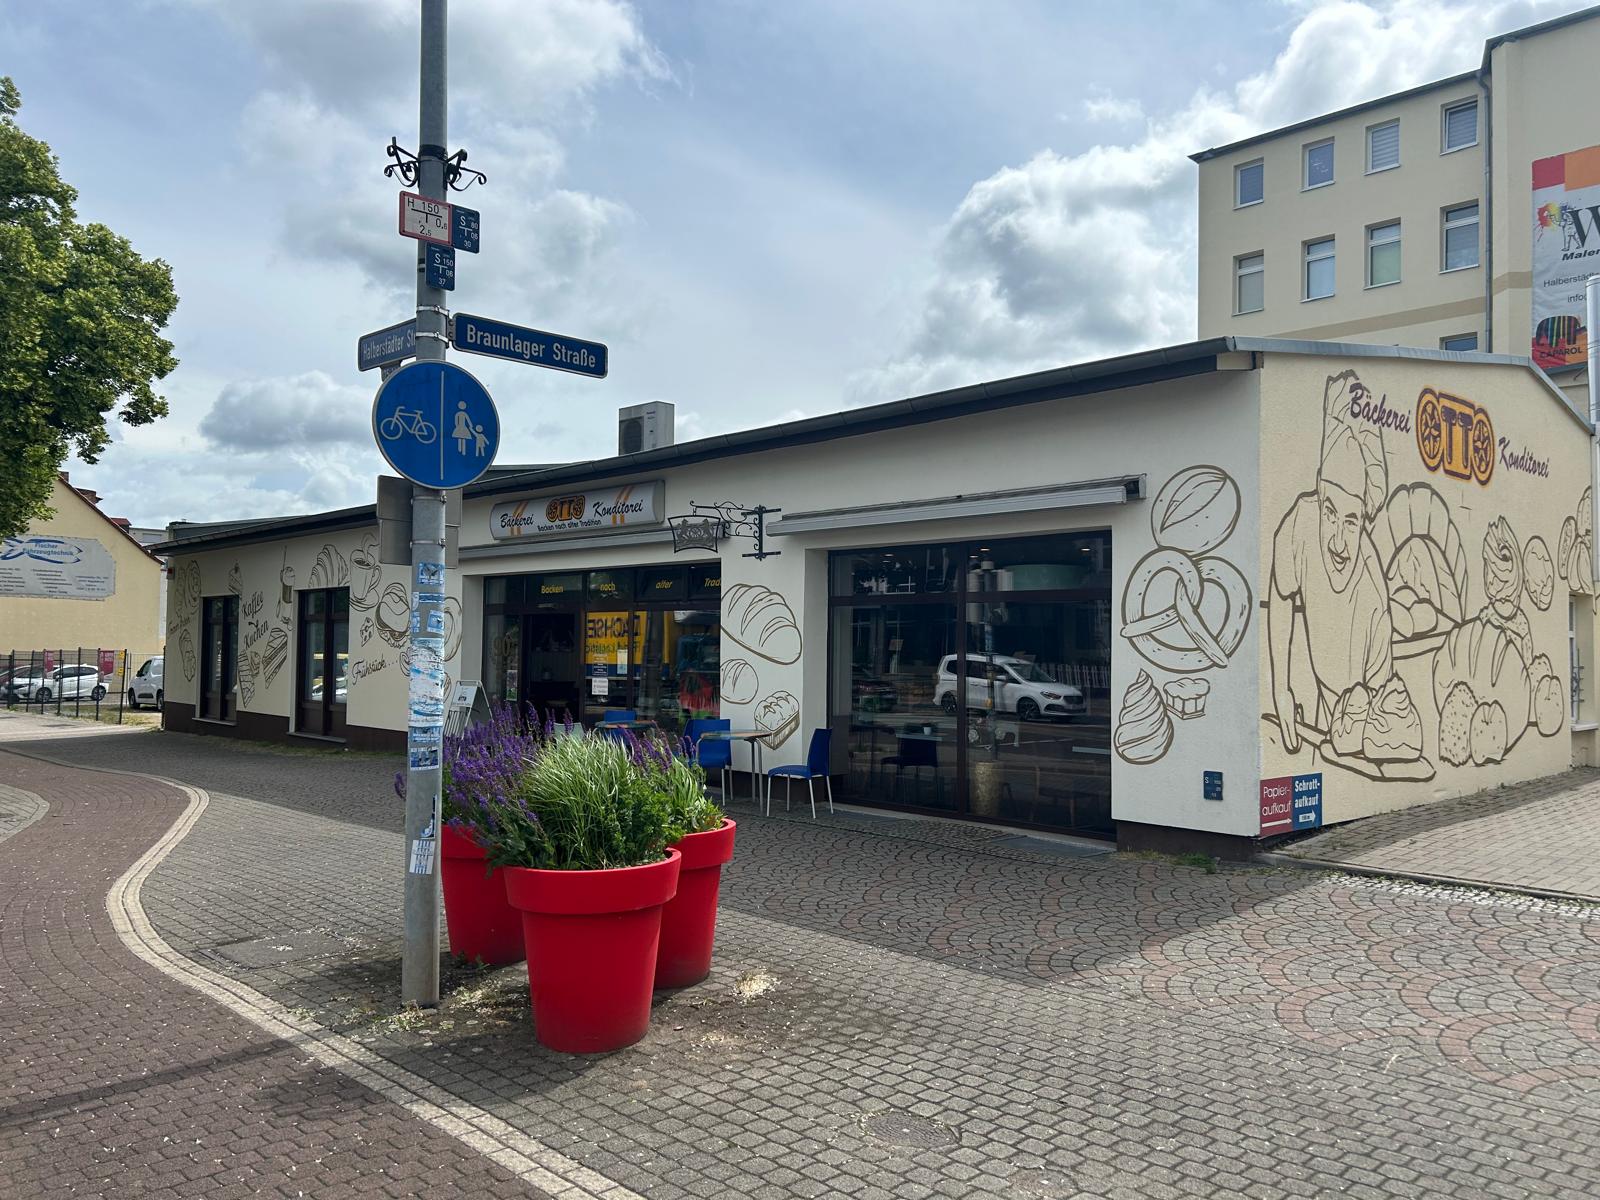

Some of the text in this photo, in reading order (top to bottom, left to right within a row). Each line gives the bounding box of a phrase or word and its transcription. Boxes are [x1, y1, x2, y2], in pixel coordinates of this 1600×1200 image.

[407, 198, 440, 214] H 150
[460, 215, 466, 226] S
[434, 253, 441, 264] S
[1567, 294, 1587, 303] info
[466, 324, 596, 368] Braunlager Straße
[1349, 382, 1550, 487] Bäckerei OTTO Konditorei
[500, 495, 644, 529] Bäckerei OTTO Konditorei
[541, 585, 564, 594] Backen
[600, 581, 616, 591] nach
[242, 592, 264, 620] Kaffee
[243, 620, 269, 650] Kuchen
[1263, 785, 1290, 799] Papier-
[1294, 778, 1321, 792] Schrott-
[1262, 800, 1292, 816] aufkauf
[1294, 793, 1319, 808] aufkauf
